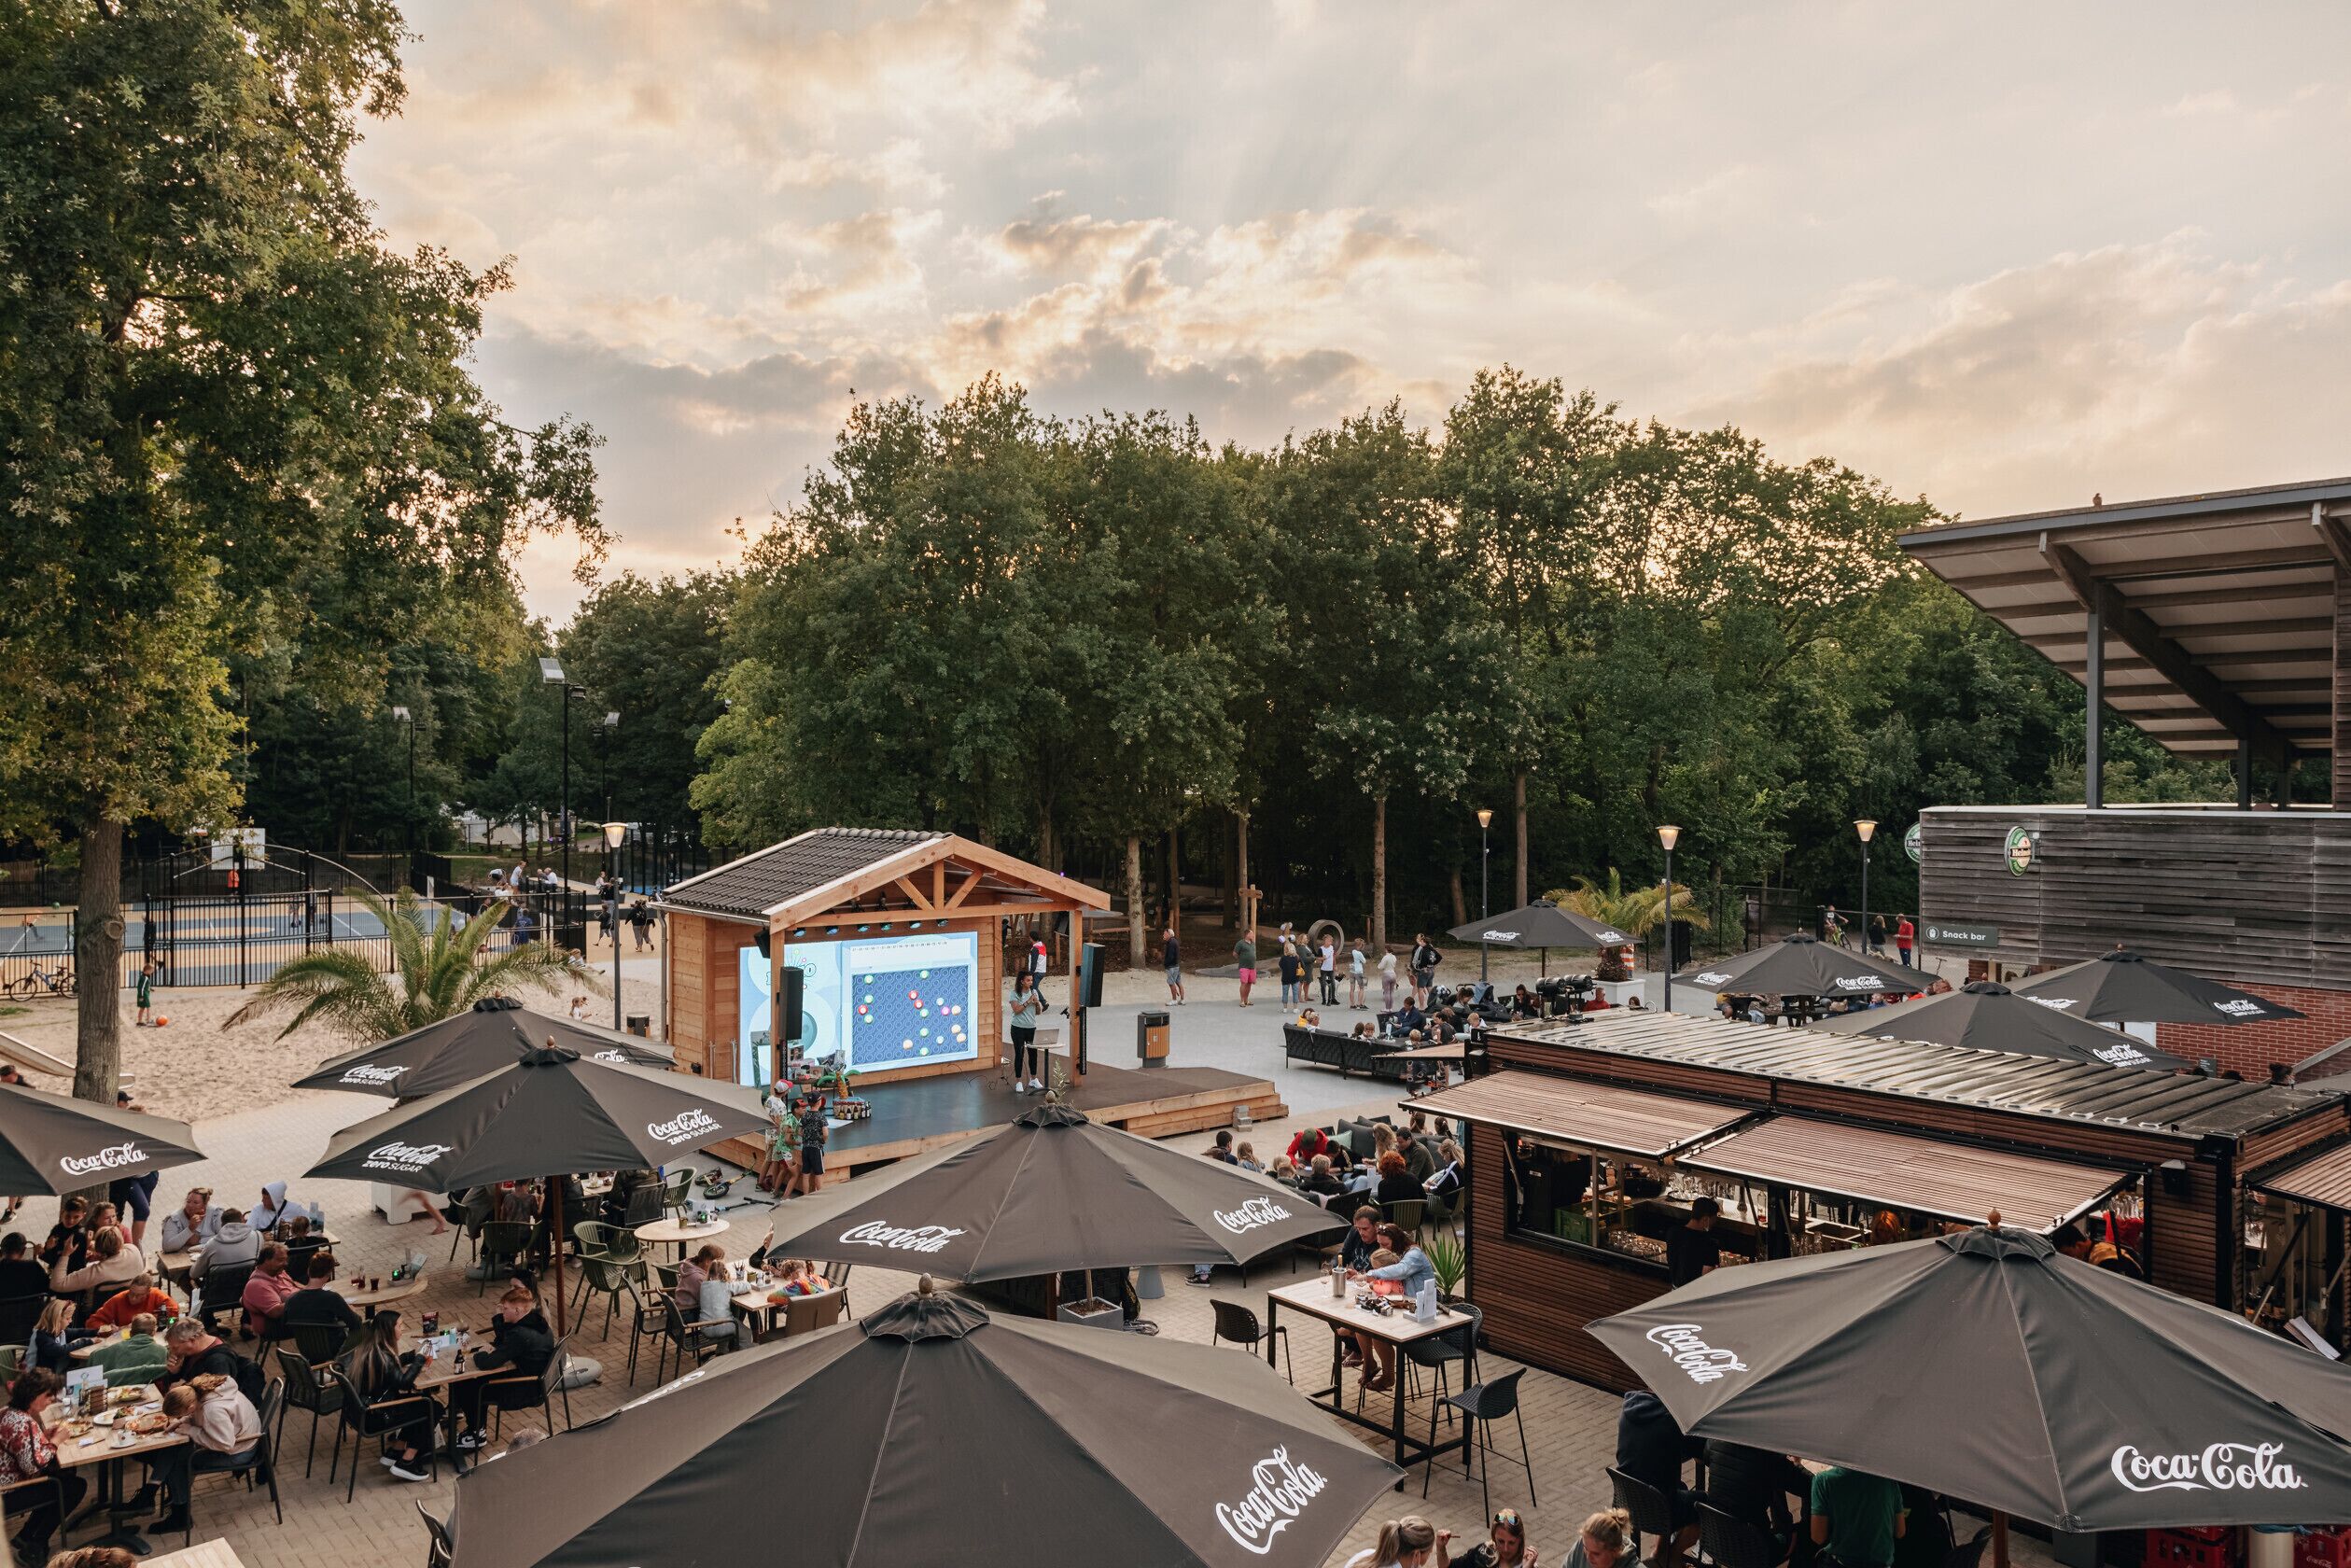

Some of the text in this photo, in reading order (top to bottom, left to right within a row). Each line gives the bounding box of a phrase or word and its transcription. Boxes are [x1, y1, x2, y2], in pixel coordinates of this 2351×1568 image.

[1942, 931, 1986, 942] Snack bar
[647, 1108, 717, 1141] Coca-Cola
[667, 1122, 722, 1146] zero SUGAR
[60, 1141, 150, 1176] Coca-Cola
[361, 1159, 423, 1173] zero SUGAR
[368, 1141, 455, 1166] Coca-Cola
[1212, 1195, 1293, 1235] Coca-Cola
[839, 1220, 968, 1253] Coca-Cola
[1645, 1323, 1750, 1385] Coca-Cola
[2110, 1442, 2309, 1492] Coca-Cola
[1215, 1442, 1328, 1555] Coca-Cola
